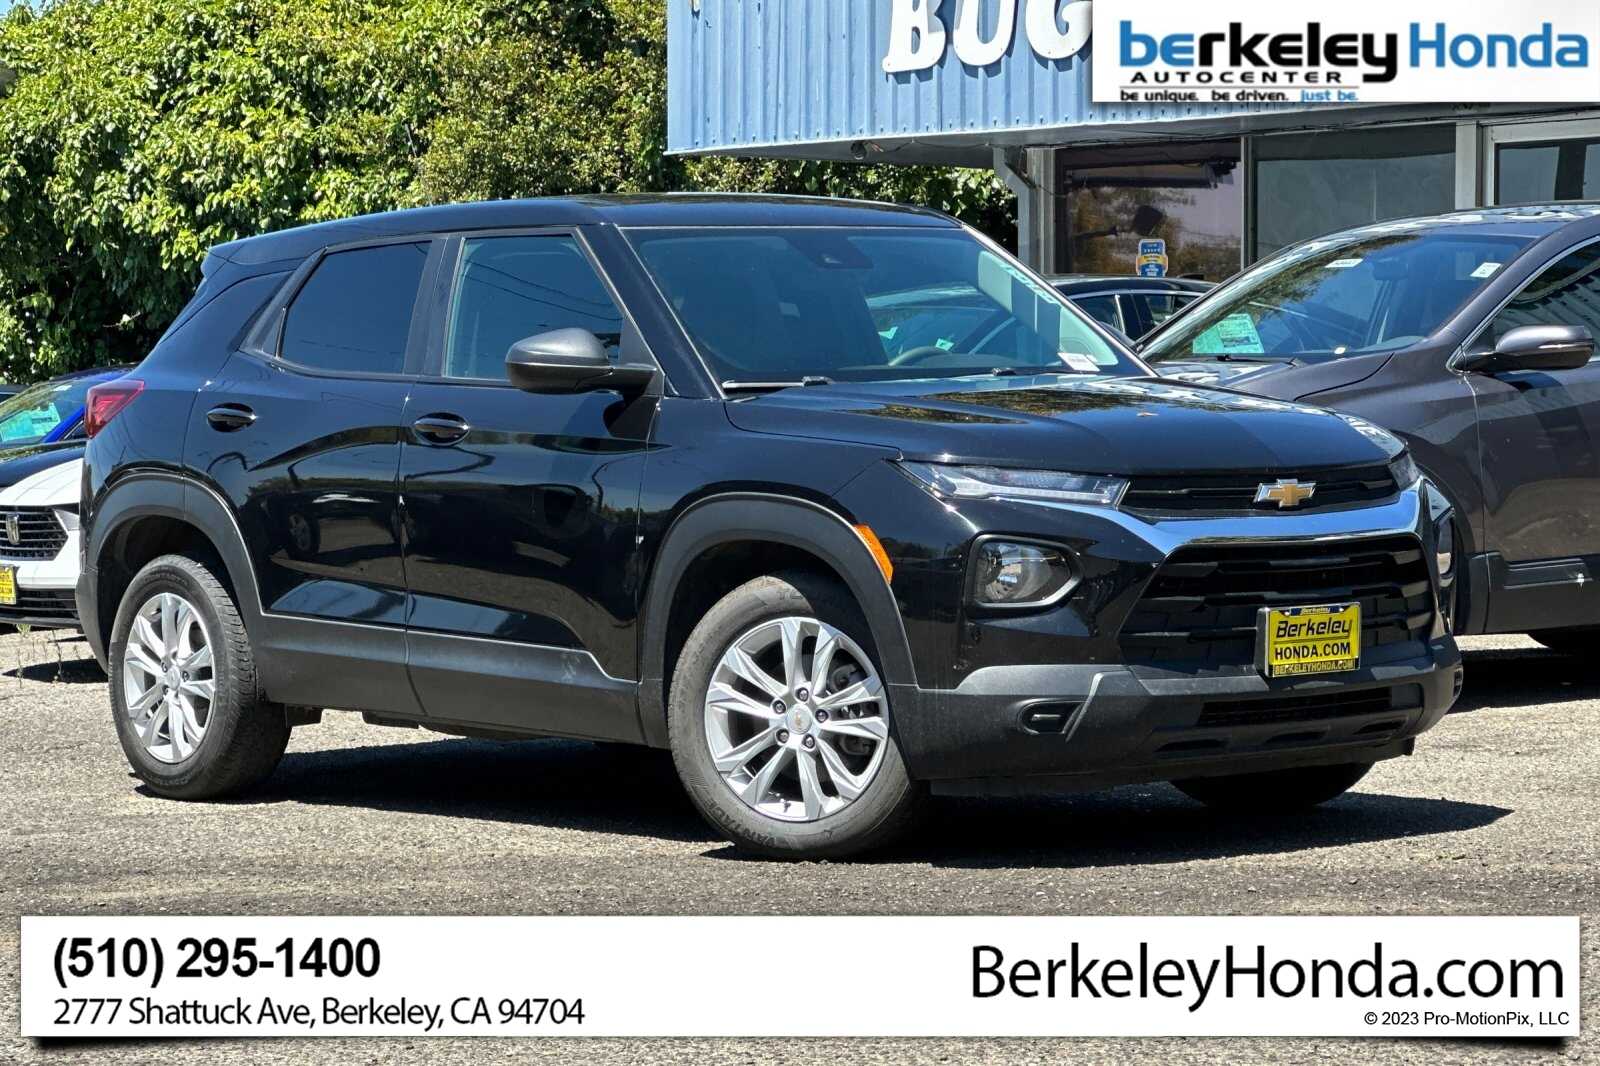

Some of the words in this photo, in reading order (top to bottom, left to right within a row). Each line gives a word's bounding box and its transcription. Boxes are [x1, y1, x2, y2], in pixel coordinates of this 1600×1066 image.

[1276, 617, 1353, 639] Berkeley
[1275, 642, 1351, 660] HONDA.COM
[1275, 660, 1355, 675] BERKELEYHONDA.COM
